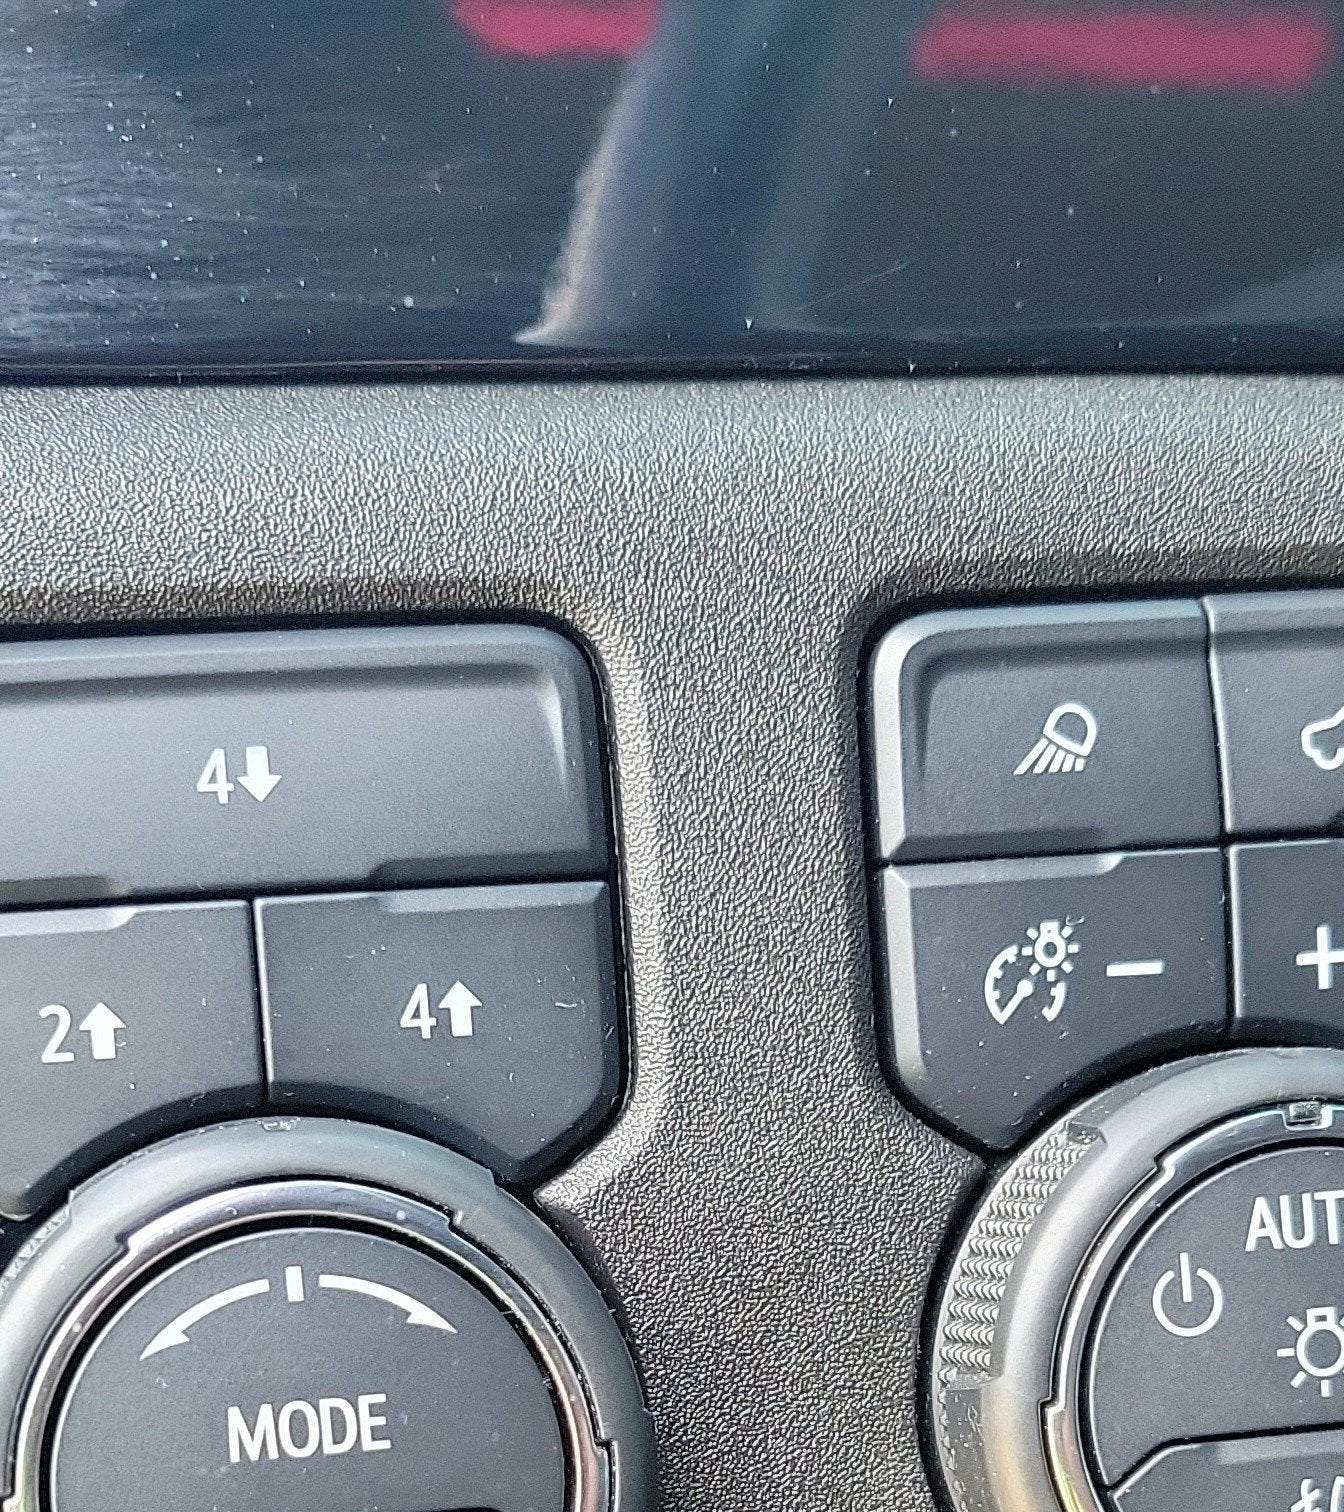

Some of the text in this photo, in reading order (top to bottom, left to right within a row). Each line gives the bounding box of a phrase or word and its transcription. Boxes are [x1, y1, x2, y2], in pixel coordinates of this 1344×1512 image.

[196, 747, 234, 804] 4
[38, 1005, 75, 1064] 2
[399, 983, 436, 1040] 4
[227, 1393, 392, 1463] MODE
